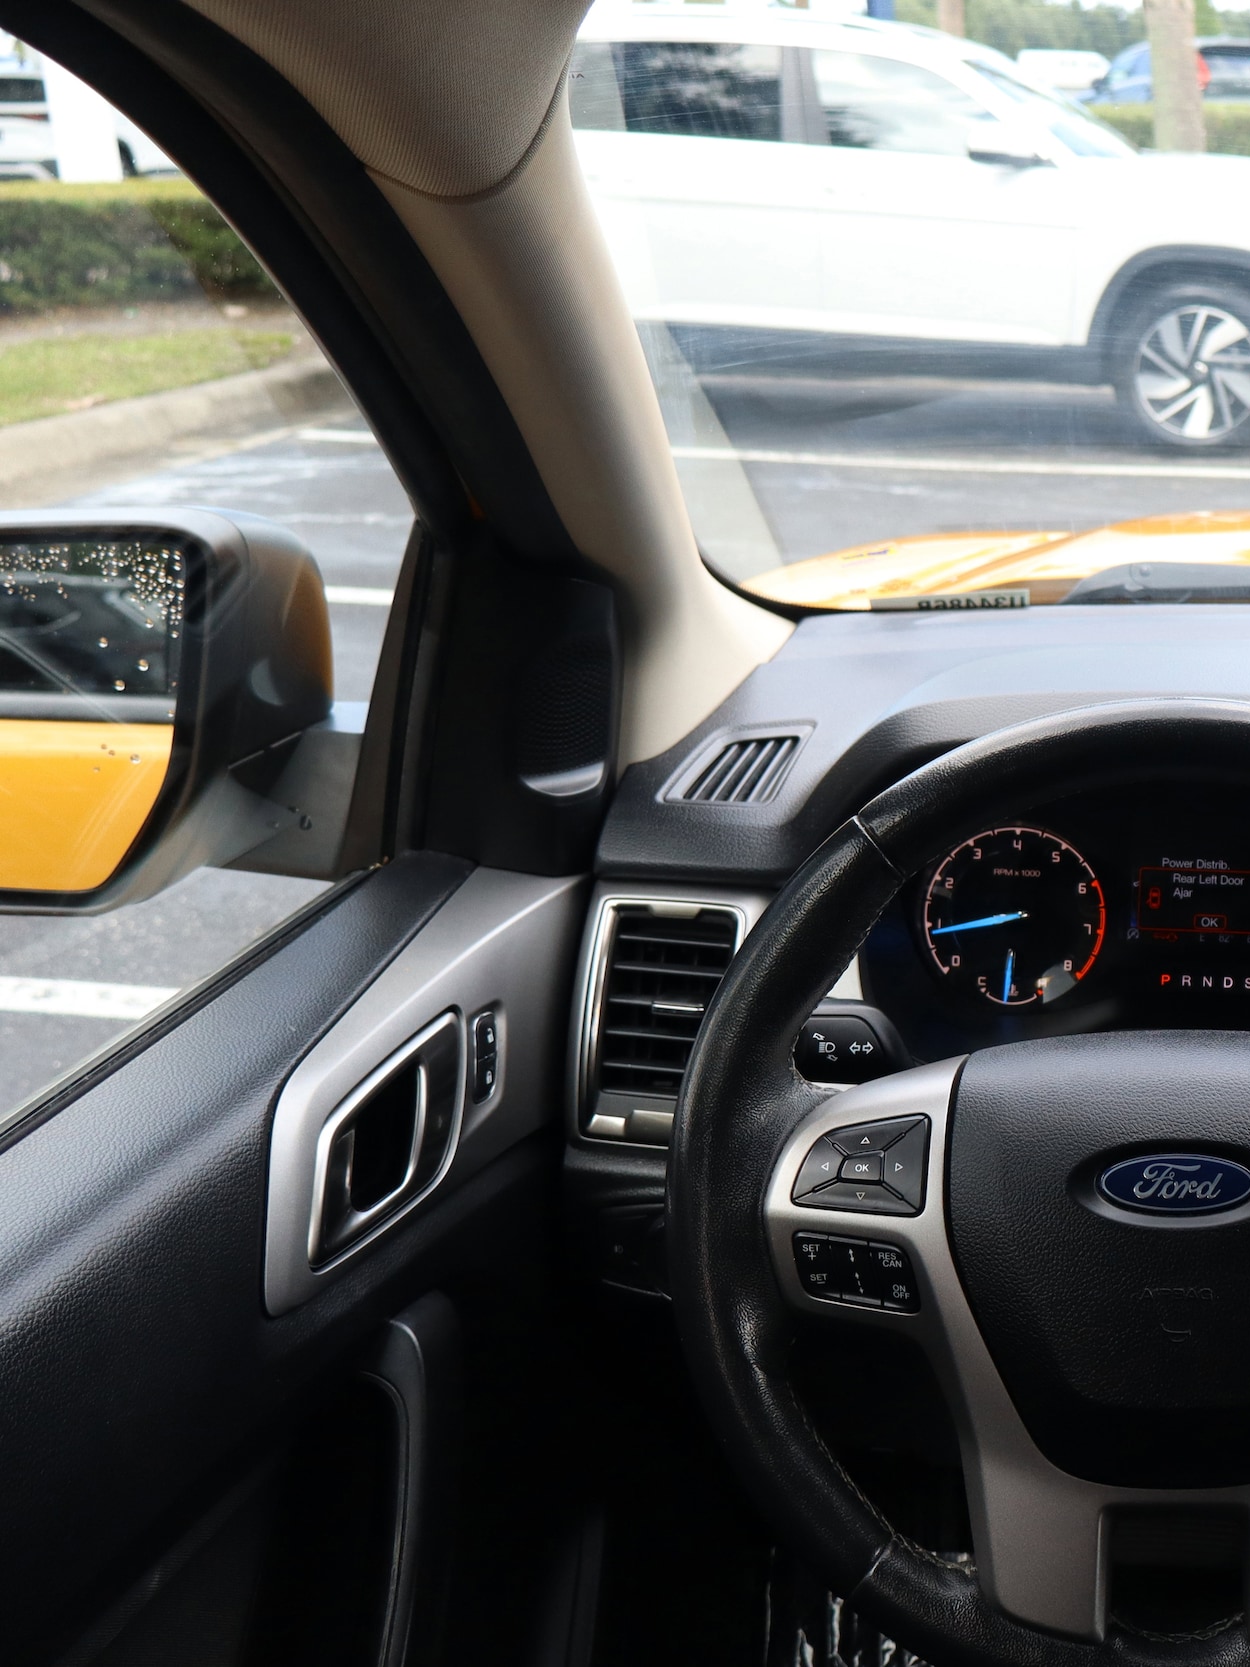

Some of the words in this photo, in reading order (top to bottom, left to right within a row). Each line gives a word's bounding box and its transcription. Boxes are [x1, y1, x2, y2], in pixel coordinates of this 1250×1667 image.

[1013, 839, 1022, 850] 4
[973, 848, 982, 860] 3
[1052, 851, 1060, 863] 5
[1162, 857, 1193, 869] Power
[1196, 859, 1230, 870] Distrib.
[993, 868, 1013, 876] RPM
[1021, 869, 1041, 877] 1000
[945, 877, 954, 889] 2
[1172, 873, 1196, 884] Rear
[1199, 874, 1218, 884] Left
[1220, 875, 1245, 886] Door
[1078, 883, 1087, 894] 6
[1172, 887, 1193, 899] Ajar
[1201, 917, 1218, 927] OK
[1084, 923, 1092, 935] 7
[951, 955, 960, 966] 0
[1064, 959, 1072, 971] 8
[977, 976, 987, 986] C
[1161, 974, 1171, 985] P
[1182, 975, 1192, 987] R
[1203, 976, 1213, 988] N
[1223, 977, 1234, 988] D
[855, 1164, 869, 1172] OK
[1133, 1163, 1223, 1199] Ford
[878, 1252, 896, 1260] RES
[893, 1284, 906, 1292] ON
